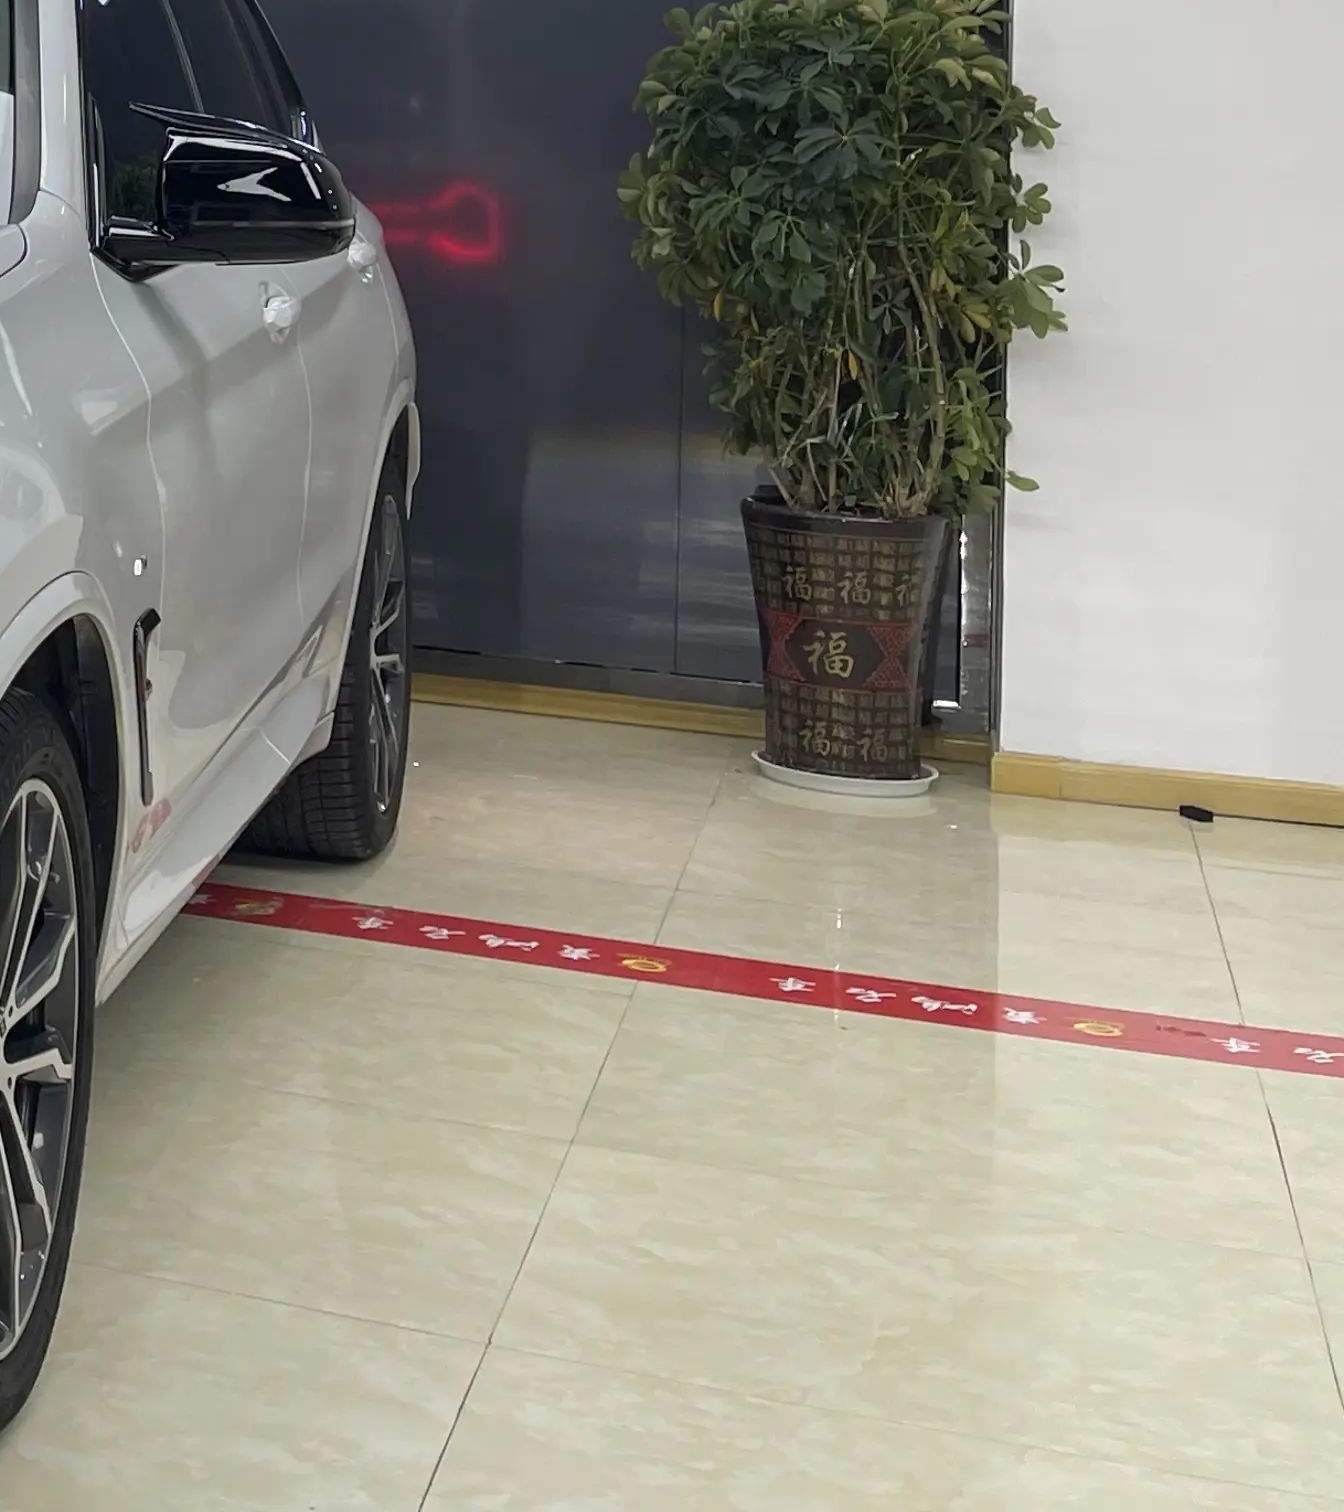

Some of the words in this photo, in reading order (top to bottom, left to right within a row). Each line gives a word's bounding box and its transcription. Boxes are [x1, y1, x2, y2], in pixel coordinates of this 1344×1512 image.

[781, 565, 811, 600] 福
[836, 571, 871, 604] 福
[802, 630, 855, 678] 福
[799, 719, 831, 756] 福
